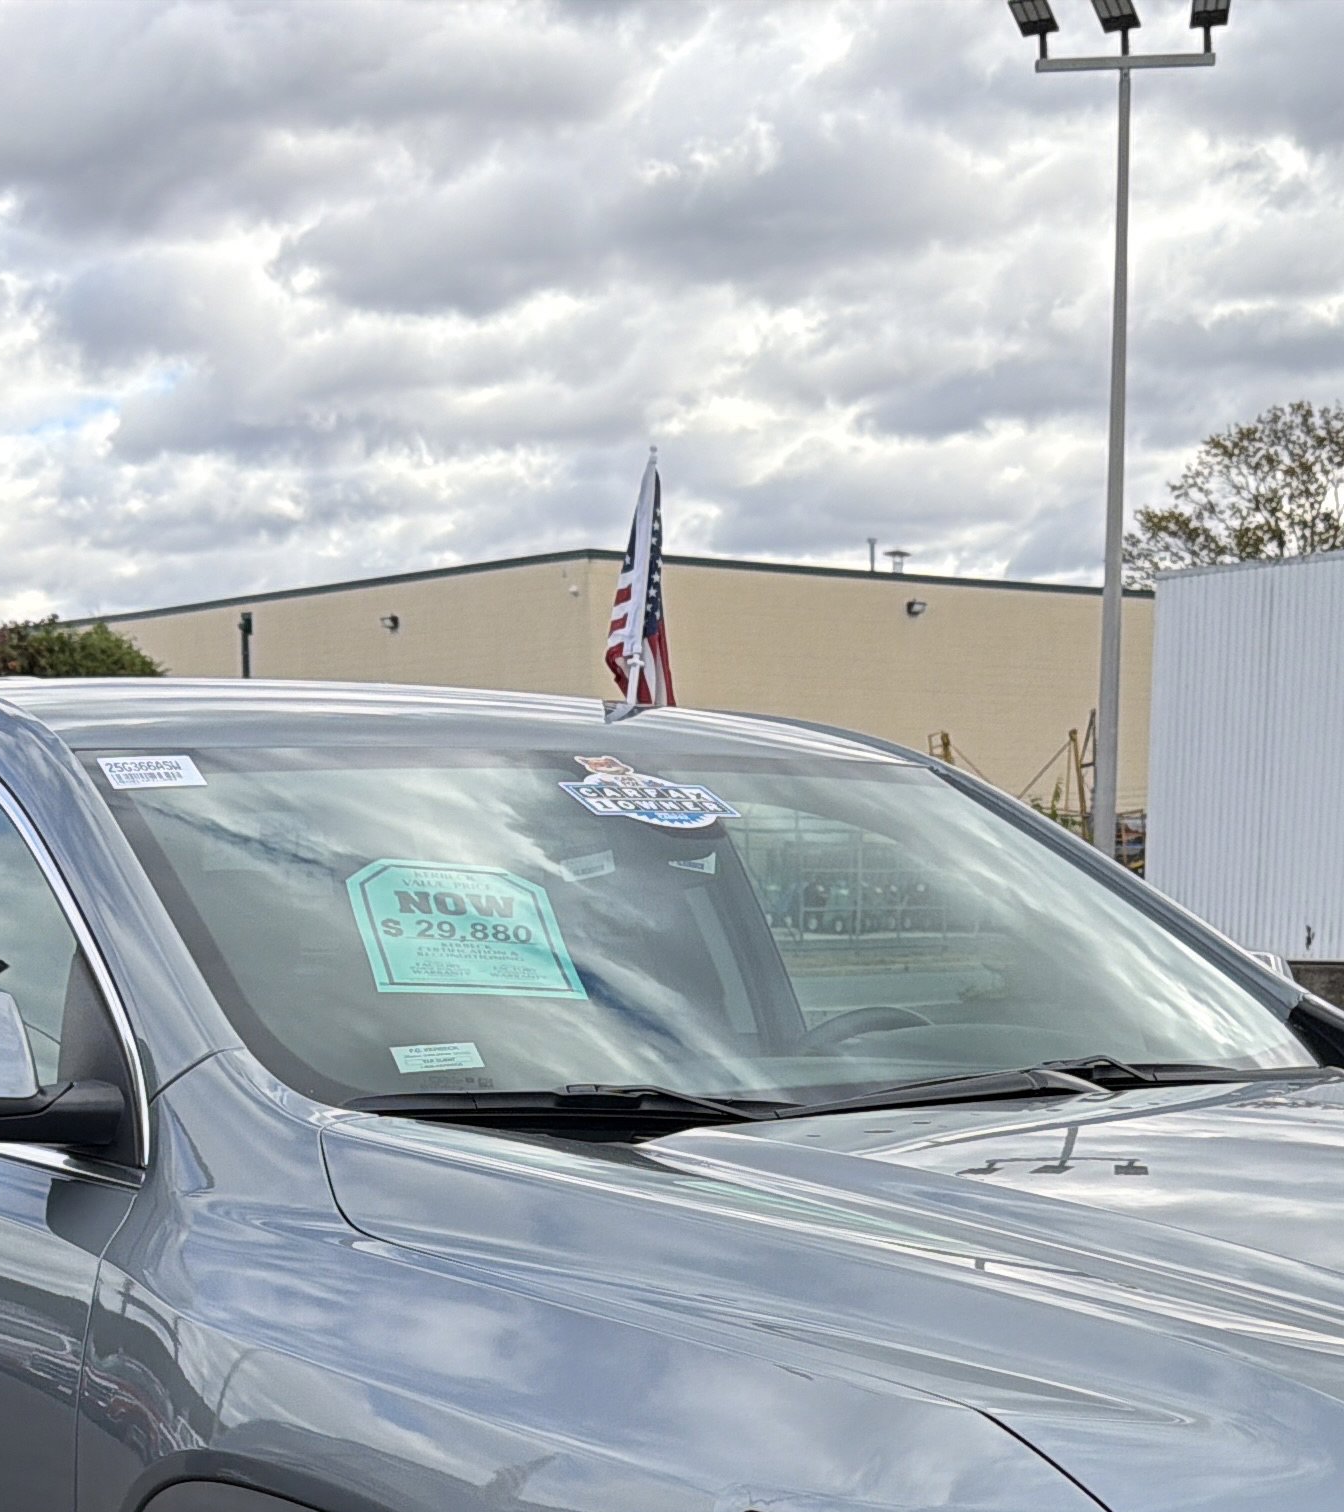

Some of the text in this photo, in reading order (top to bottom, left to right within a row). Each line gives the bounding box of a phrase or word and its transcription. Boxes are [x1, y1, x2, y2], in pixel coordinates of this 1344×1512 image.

[617, 799, 723, 812] OWNER
[393, 890, 515, 918] NOW
[381, 918, 533, 944] $ 29,880
